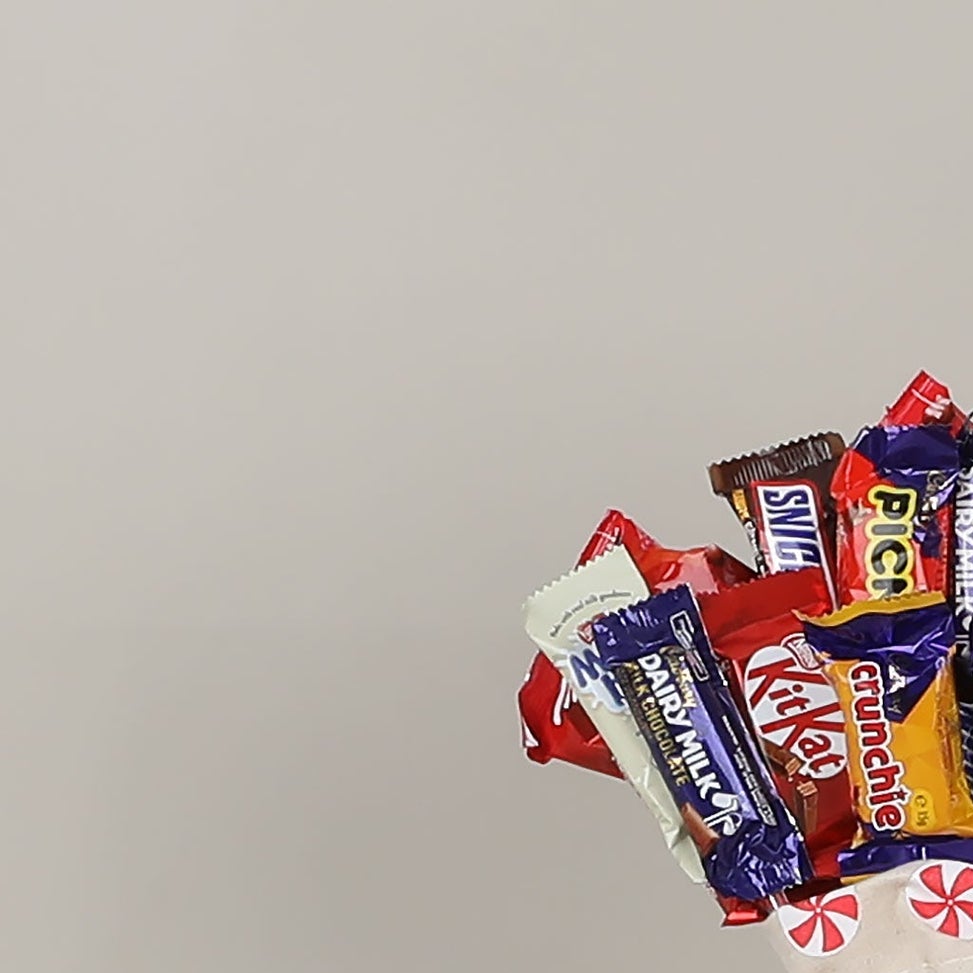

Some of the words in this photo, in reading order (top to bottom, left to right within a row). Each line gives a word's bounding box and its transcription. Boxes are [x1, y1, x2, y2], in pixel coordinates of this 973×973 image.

[637, 653, 693, 728] DAIRY
[674, 730, 722, 801] MILK
[641, 696, 691, 788] CHOCOLATE
[748, 656, 846, 773] KitKat
